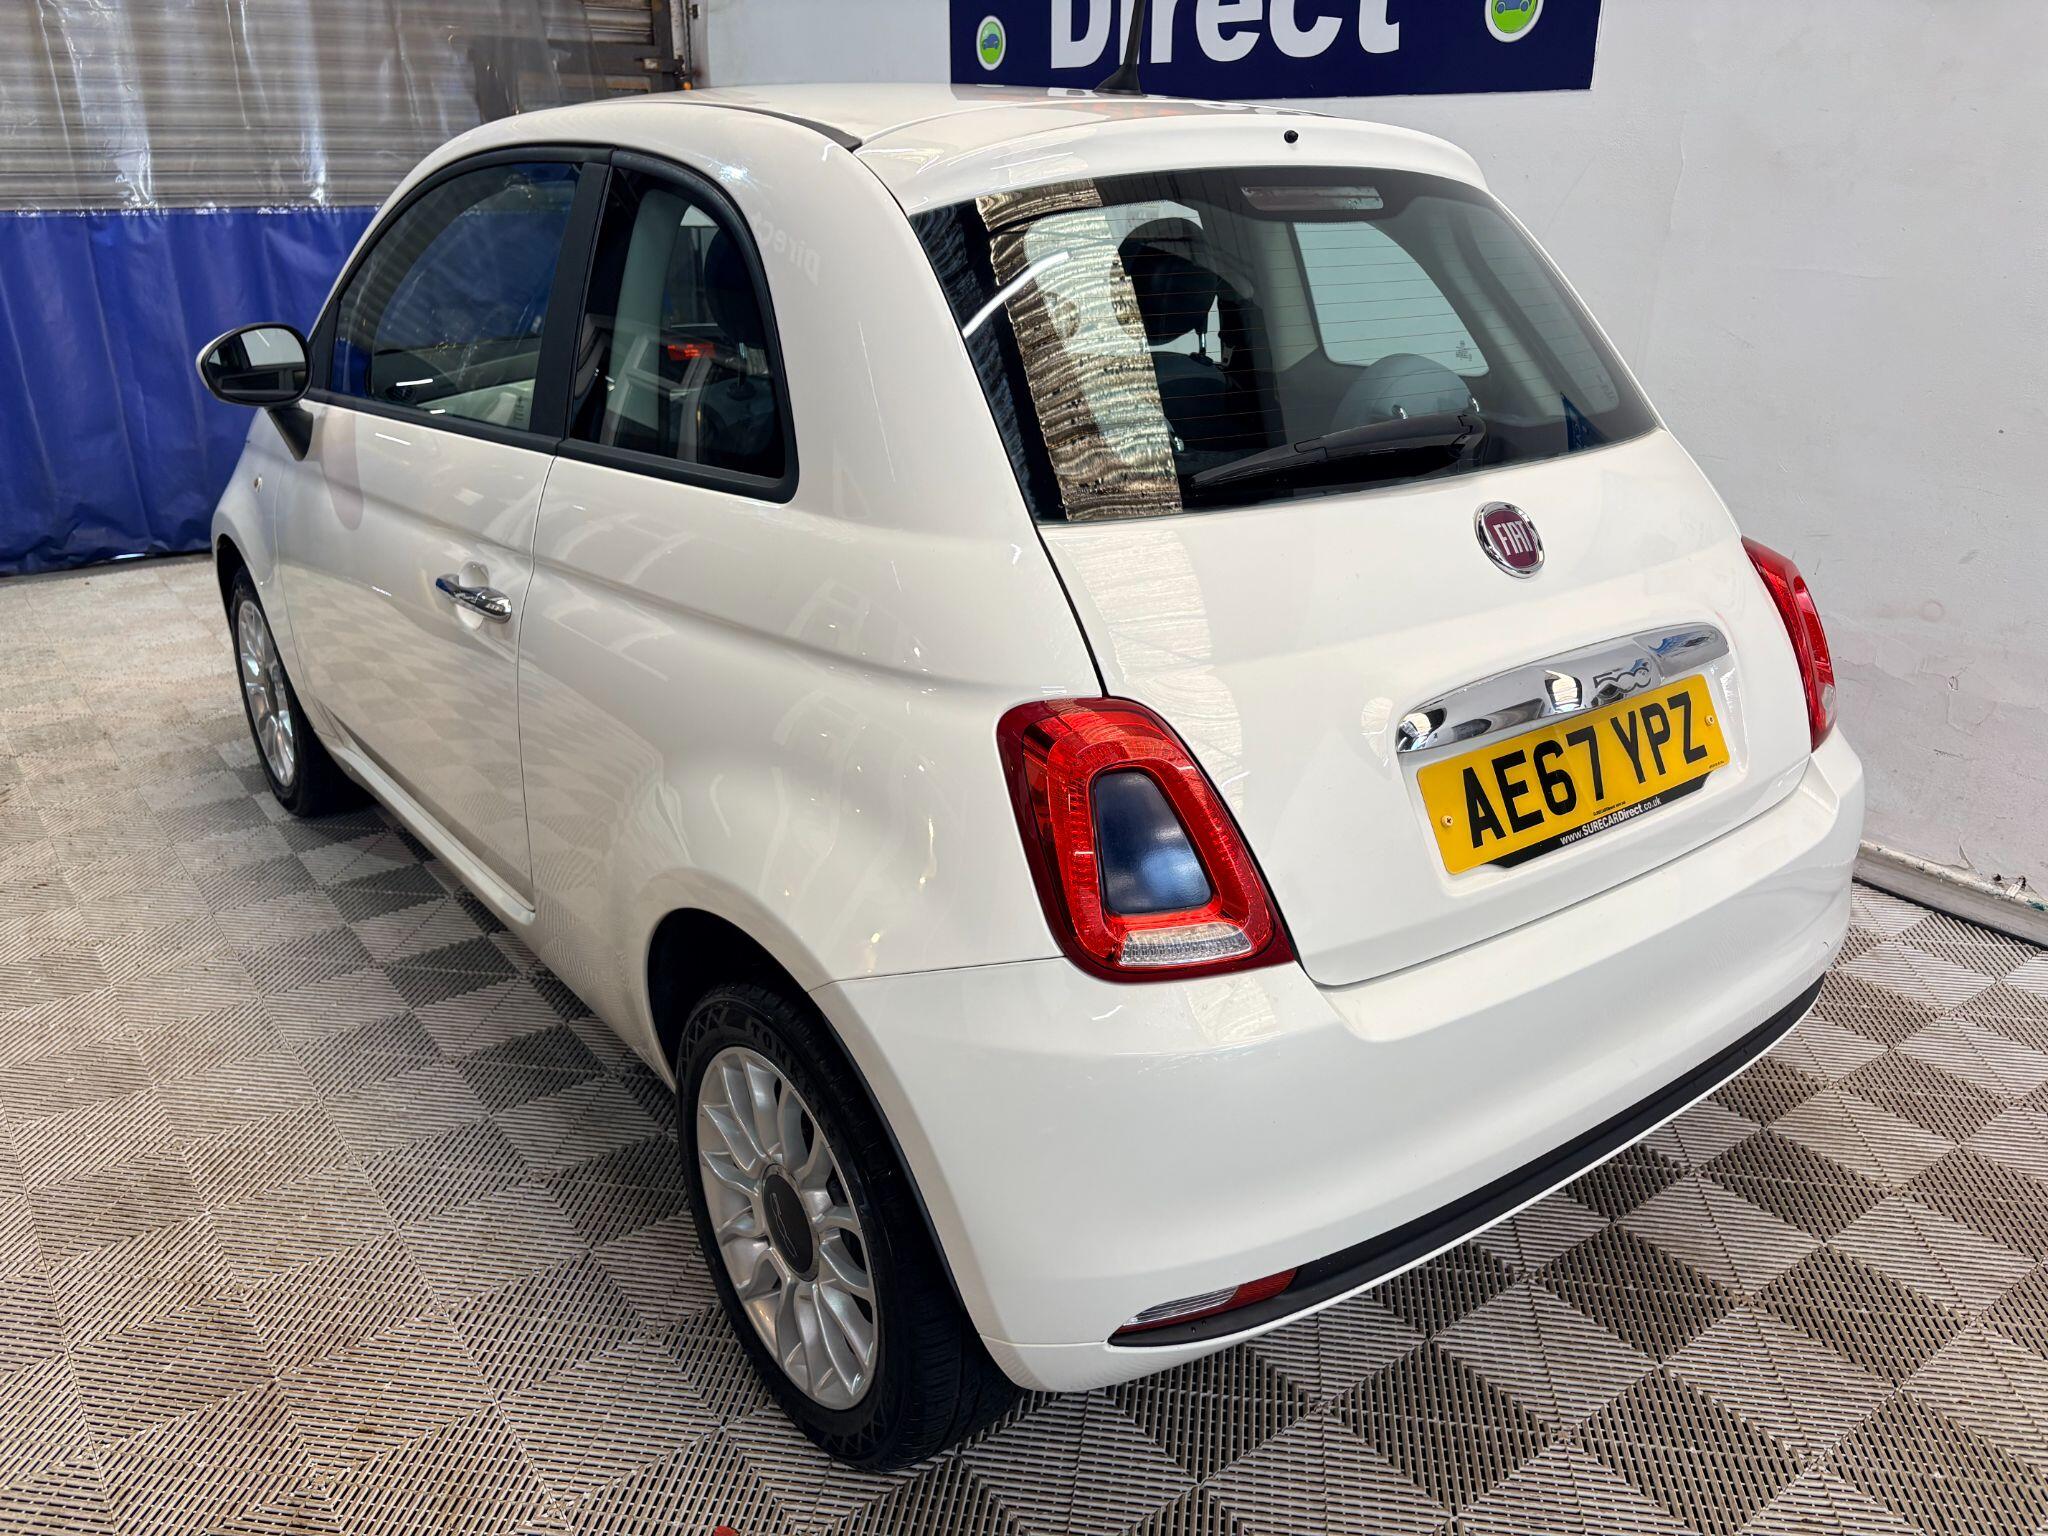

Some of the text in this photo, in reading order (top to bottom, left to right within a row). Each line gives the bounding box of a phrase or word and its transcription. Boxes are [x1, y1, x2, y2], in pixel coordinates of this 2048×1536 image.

[1492, 520, 1534, 556] FIAT
[1592, 667, 1652, 694] 500
[1462, 690, 1708, 849] AE67 YPZ
[1560, 796, 1662, 845] www.SURECARDirect.co.uk
